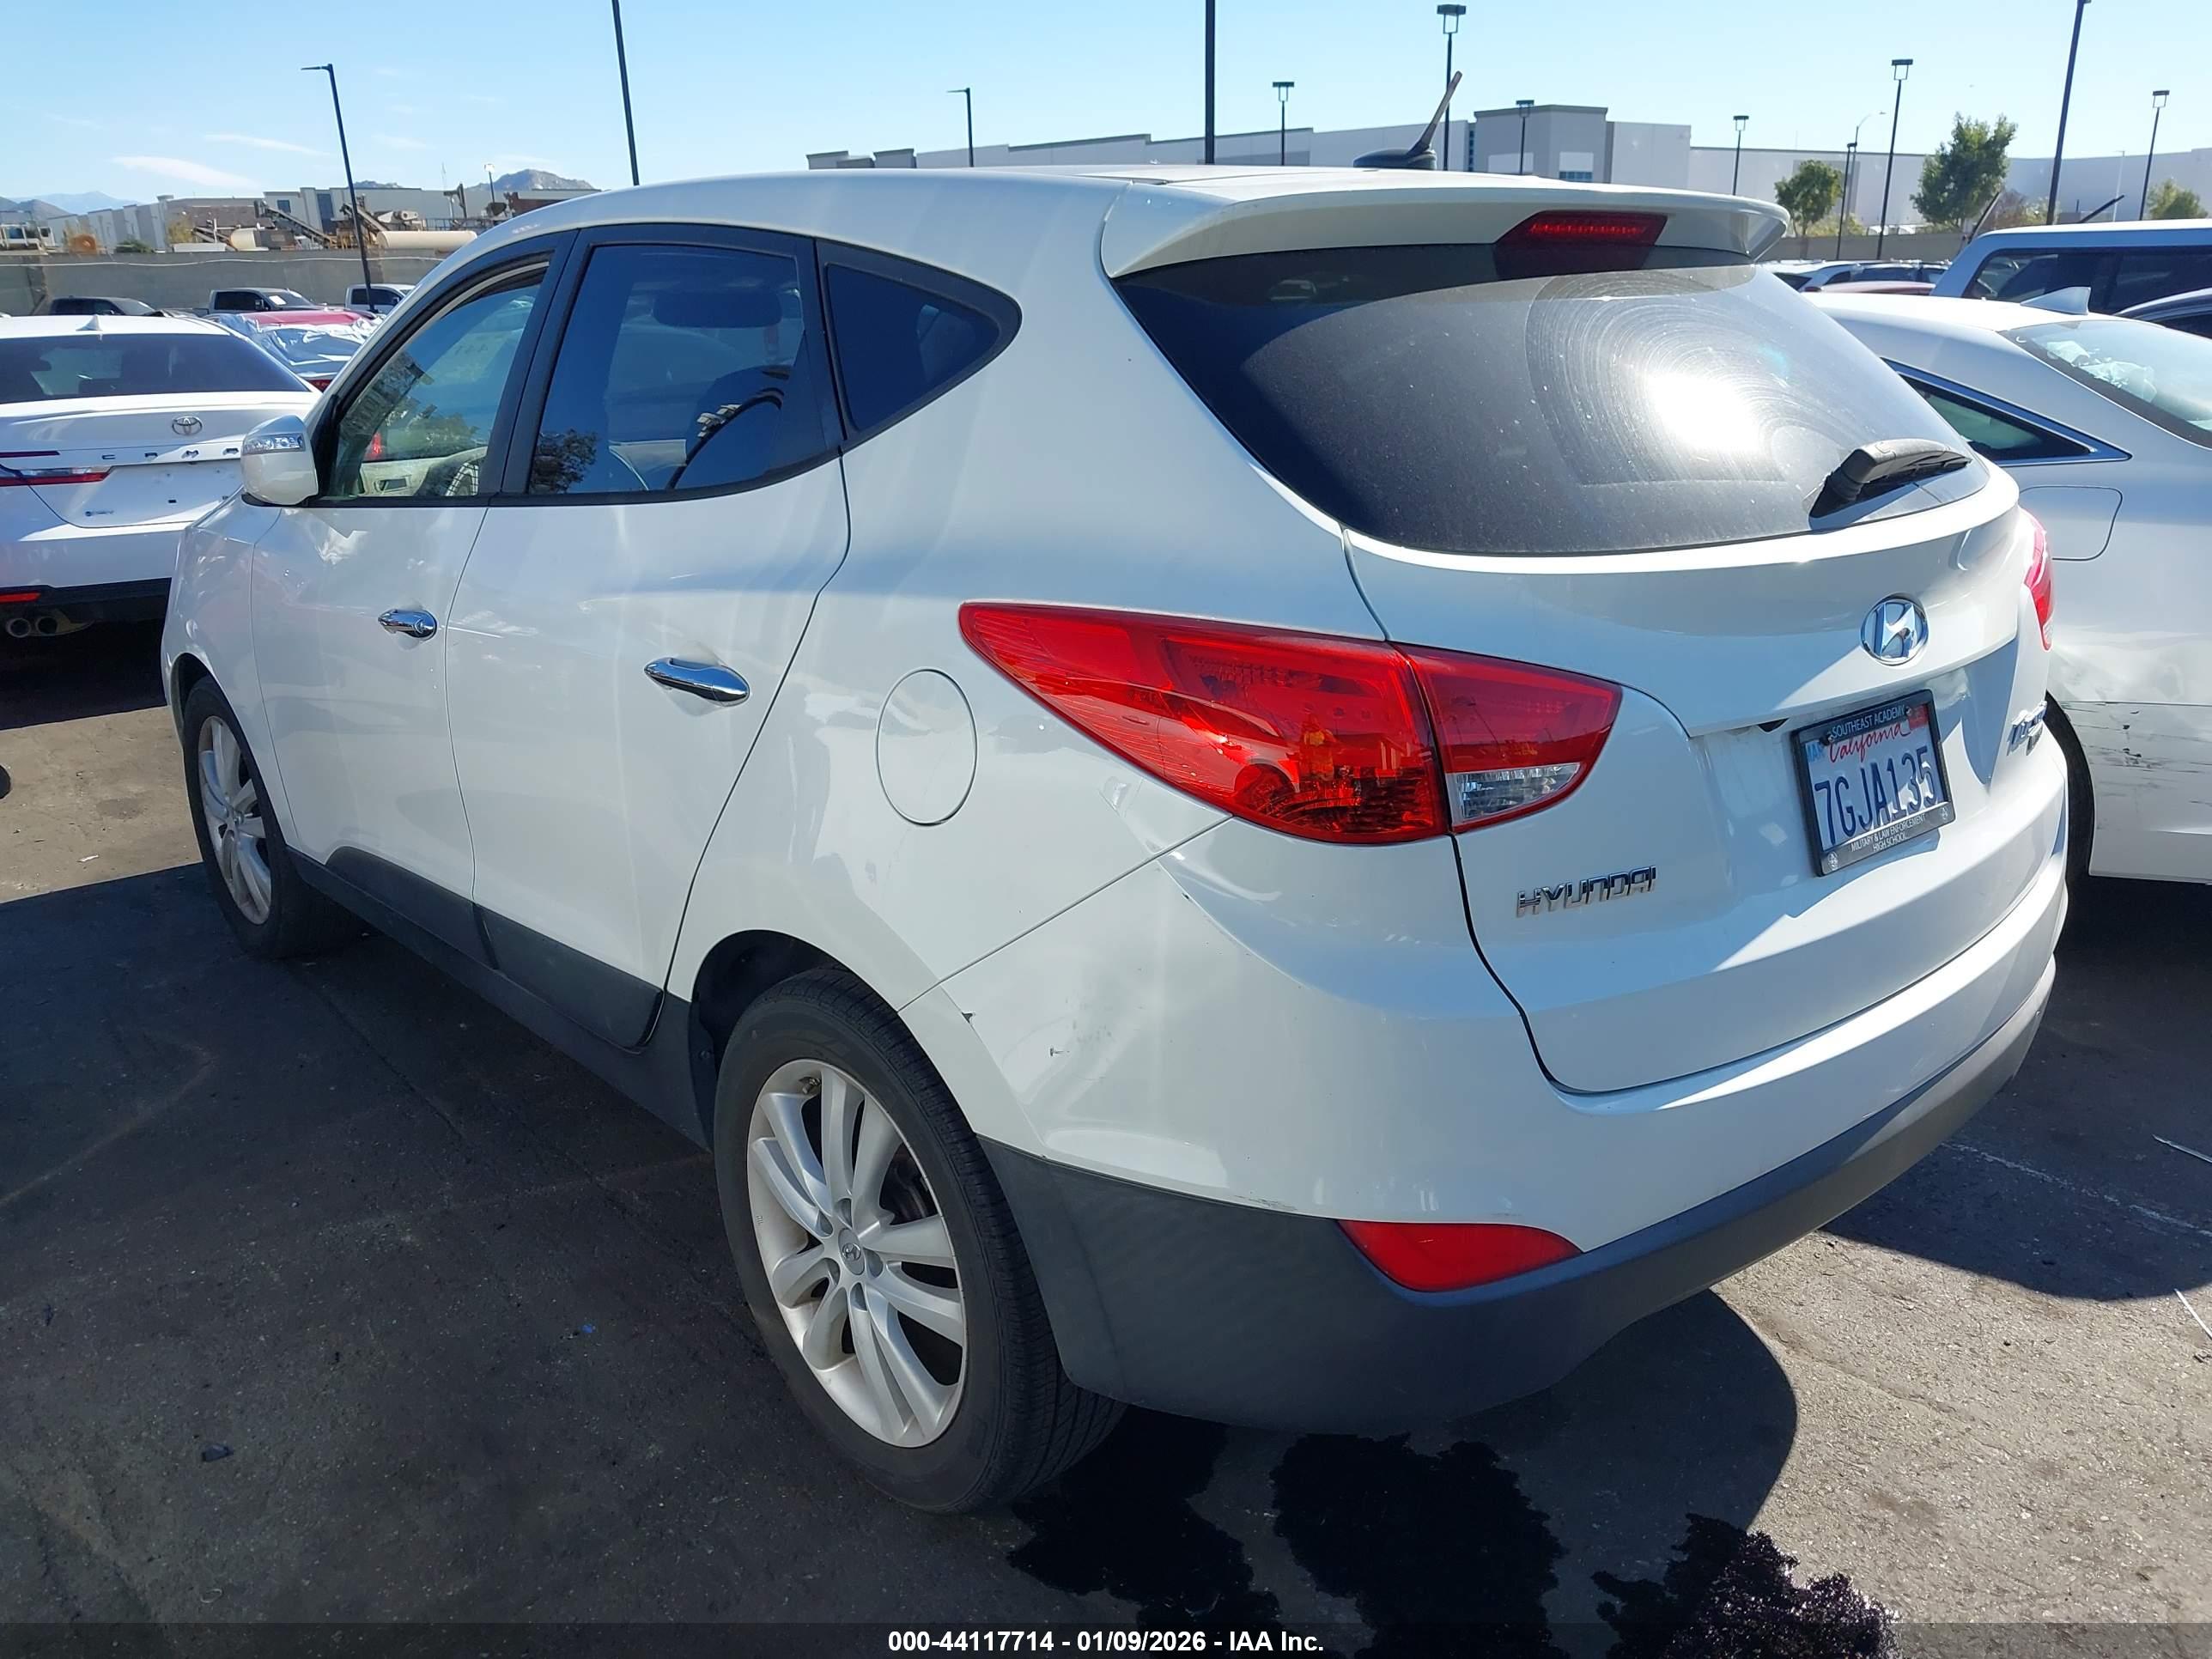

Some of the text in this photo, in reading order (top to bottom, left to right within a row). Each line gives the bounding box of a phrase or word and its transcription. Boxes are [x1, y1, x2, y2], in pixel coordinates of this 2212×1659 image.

[1832, 704, 1905, 738] SOUTHEAST ACADEMY
[1829, 721, 1911, 763] California
[1814, 745, 1937, 845] 7GJA135
[1850, 836, 1874, 852] MILITARY
[1879, 828, 1890, 840] LAW
[1890, 813, 1925, 835] ENFORCEMENT
[1873, 833, 1907, 852] HIGH SCHOOL
[1516, 865, 1656, 918] HYUNDAI
